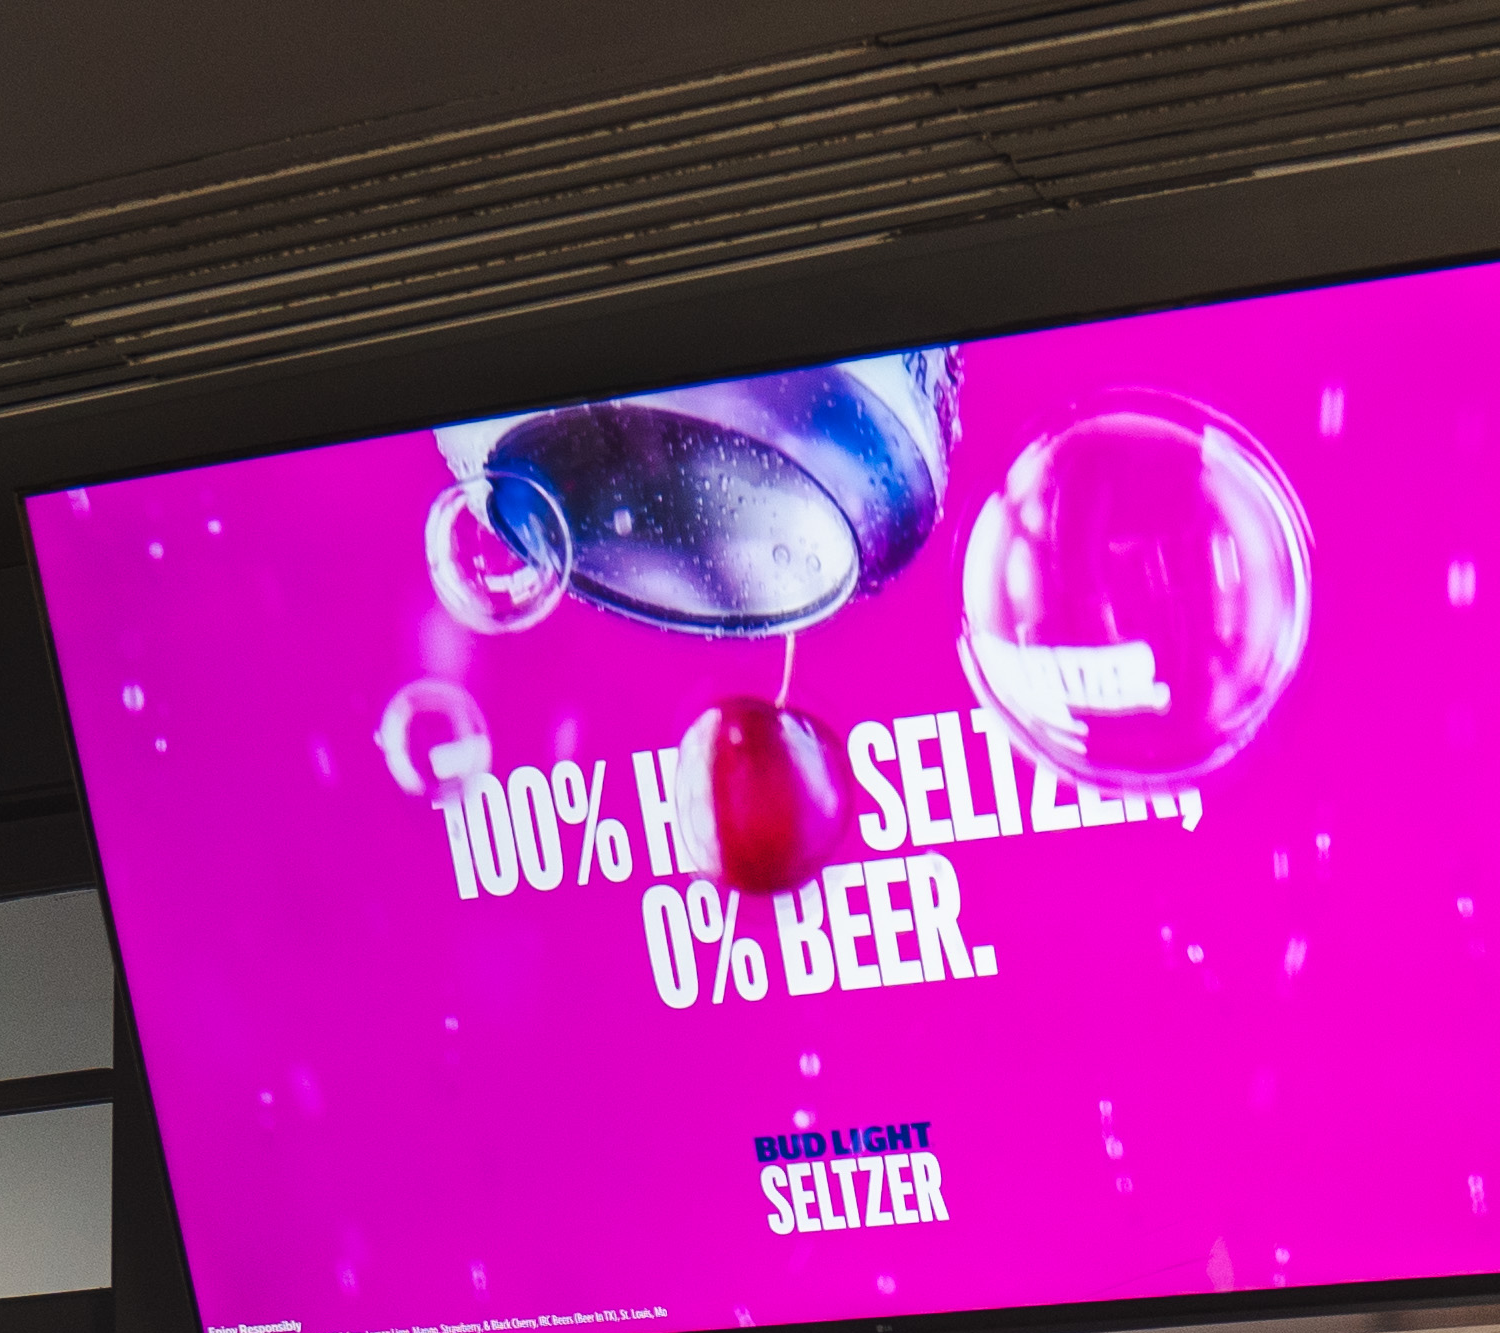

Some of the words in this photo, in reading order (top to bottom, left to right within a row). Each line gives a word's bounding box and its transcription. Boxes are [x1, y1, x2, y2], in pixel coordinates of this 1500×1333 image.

[432, 757, 634, 900] 100%
[641, 878, 768, 1010] 0%
[772, 852, 998, 998] BEER.
[753, 1131, 827, 1163] BUD
[831, 1121, 932, 1156] LIGHT
[759, 1149, 950, 1235] SELTZER
